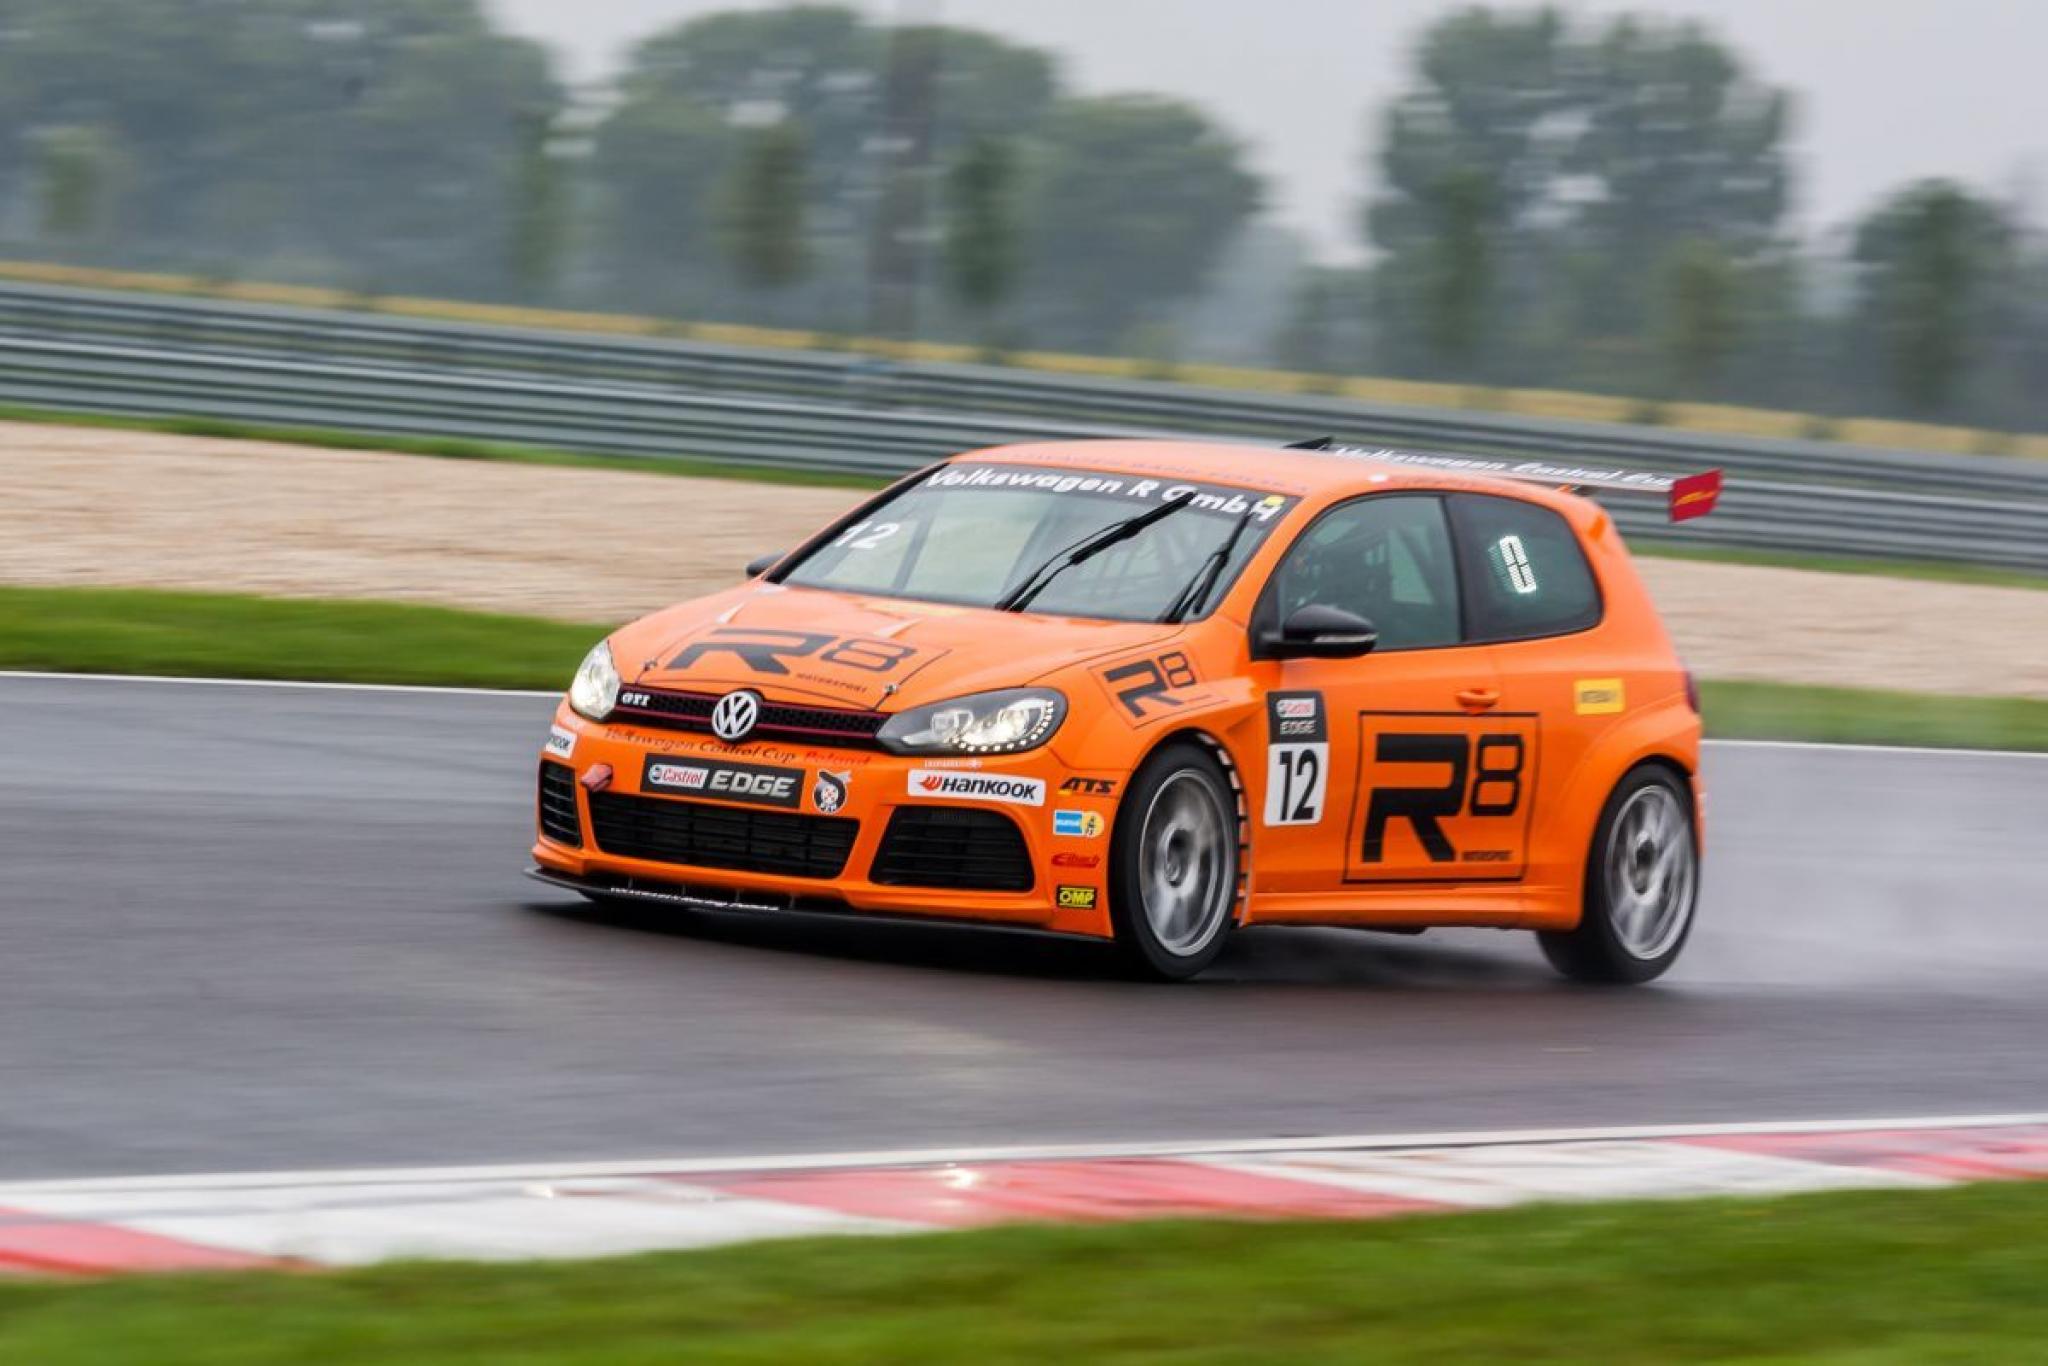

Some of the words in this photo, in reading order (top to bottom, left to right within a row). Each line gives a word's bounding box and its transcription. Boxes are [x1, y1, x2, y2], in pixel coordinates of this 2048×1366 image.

[926, 468, 1123, 493] Volkswagen
[1126, 479, 1160, 498] R
[834, 520, 900, 549] 12
[663, 628, 919, 687] R8
[622, 692, 650, 707] GTI
[1103, 651, 1197, 718] R8
[762, 750, 797, 764] Cup
[663, 766, 704, 786] Castrol
[708, 769, 797, 798] EDGE
[1279, 749, 1318, 821] 12
[1361, 732, 1525, 863] R8
[1060, 890, 1094, 905] OMP
